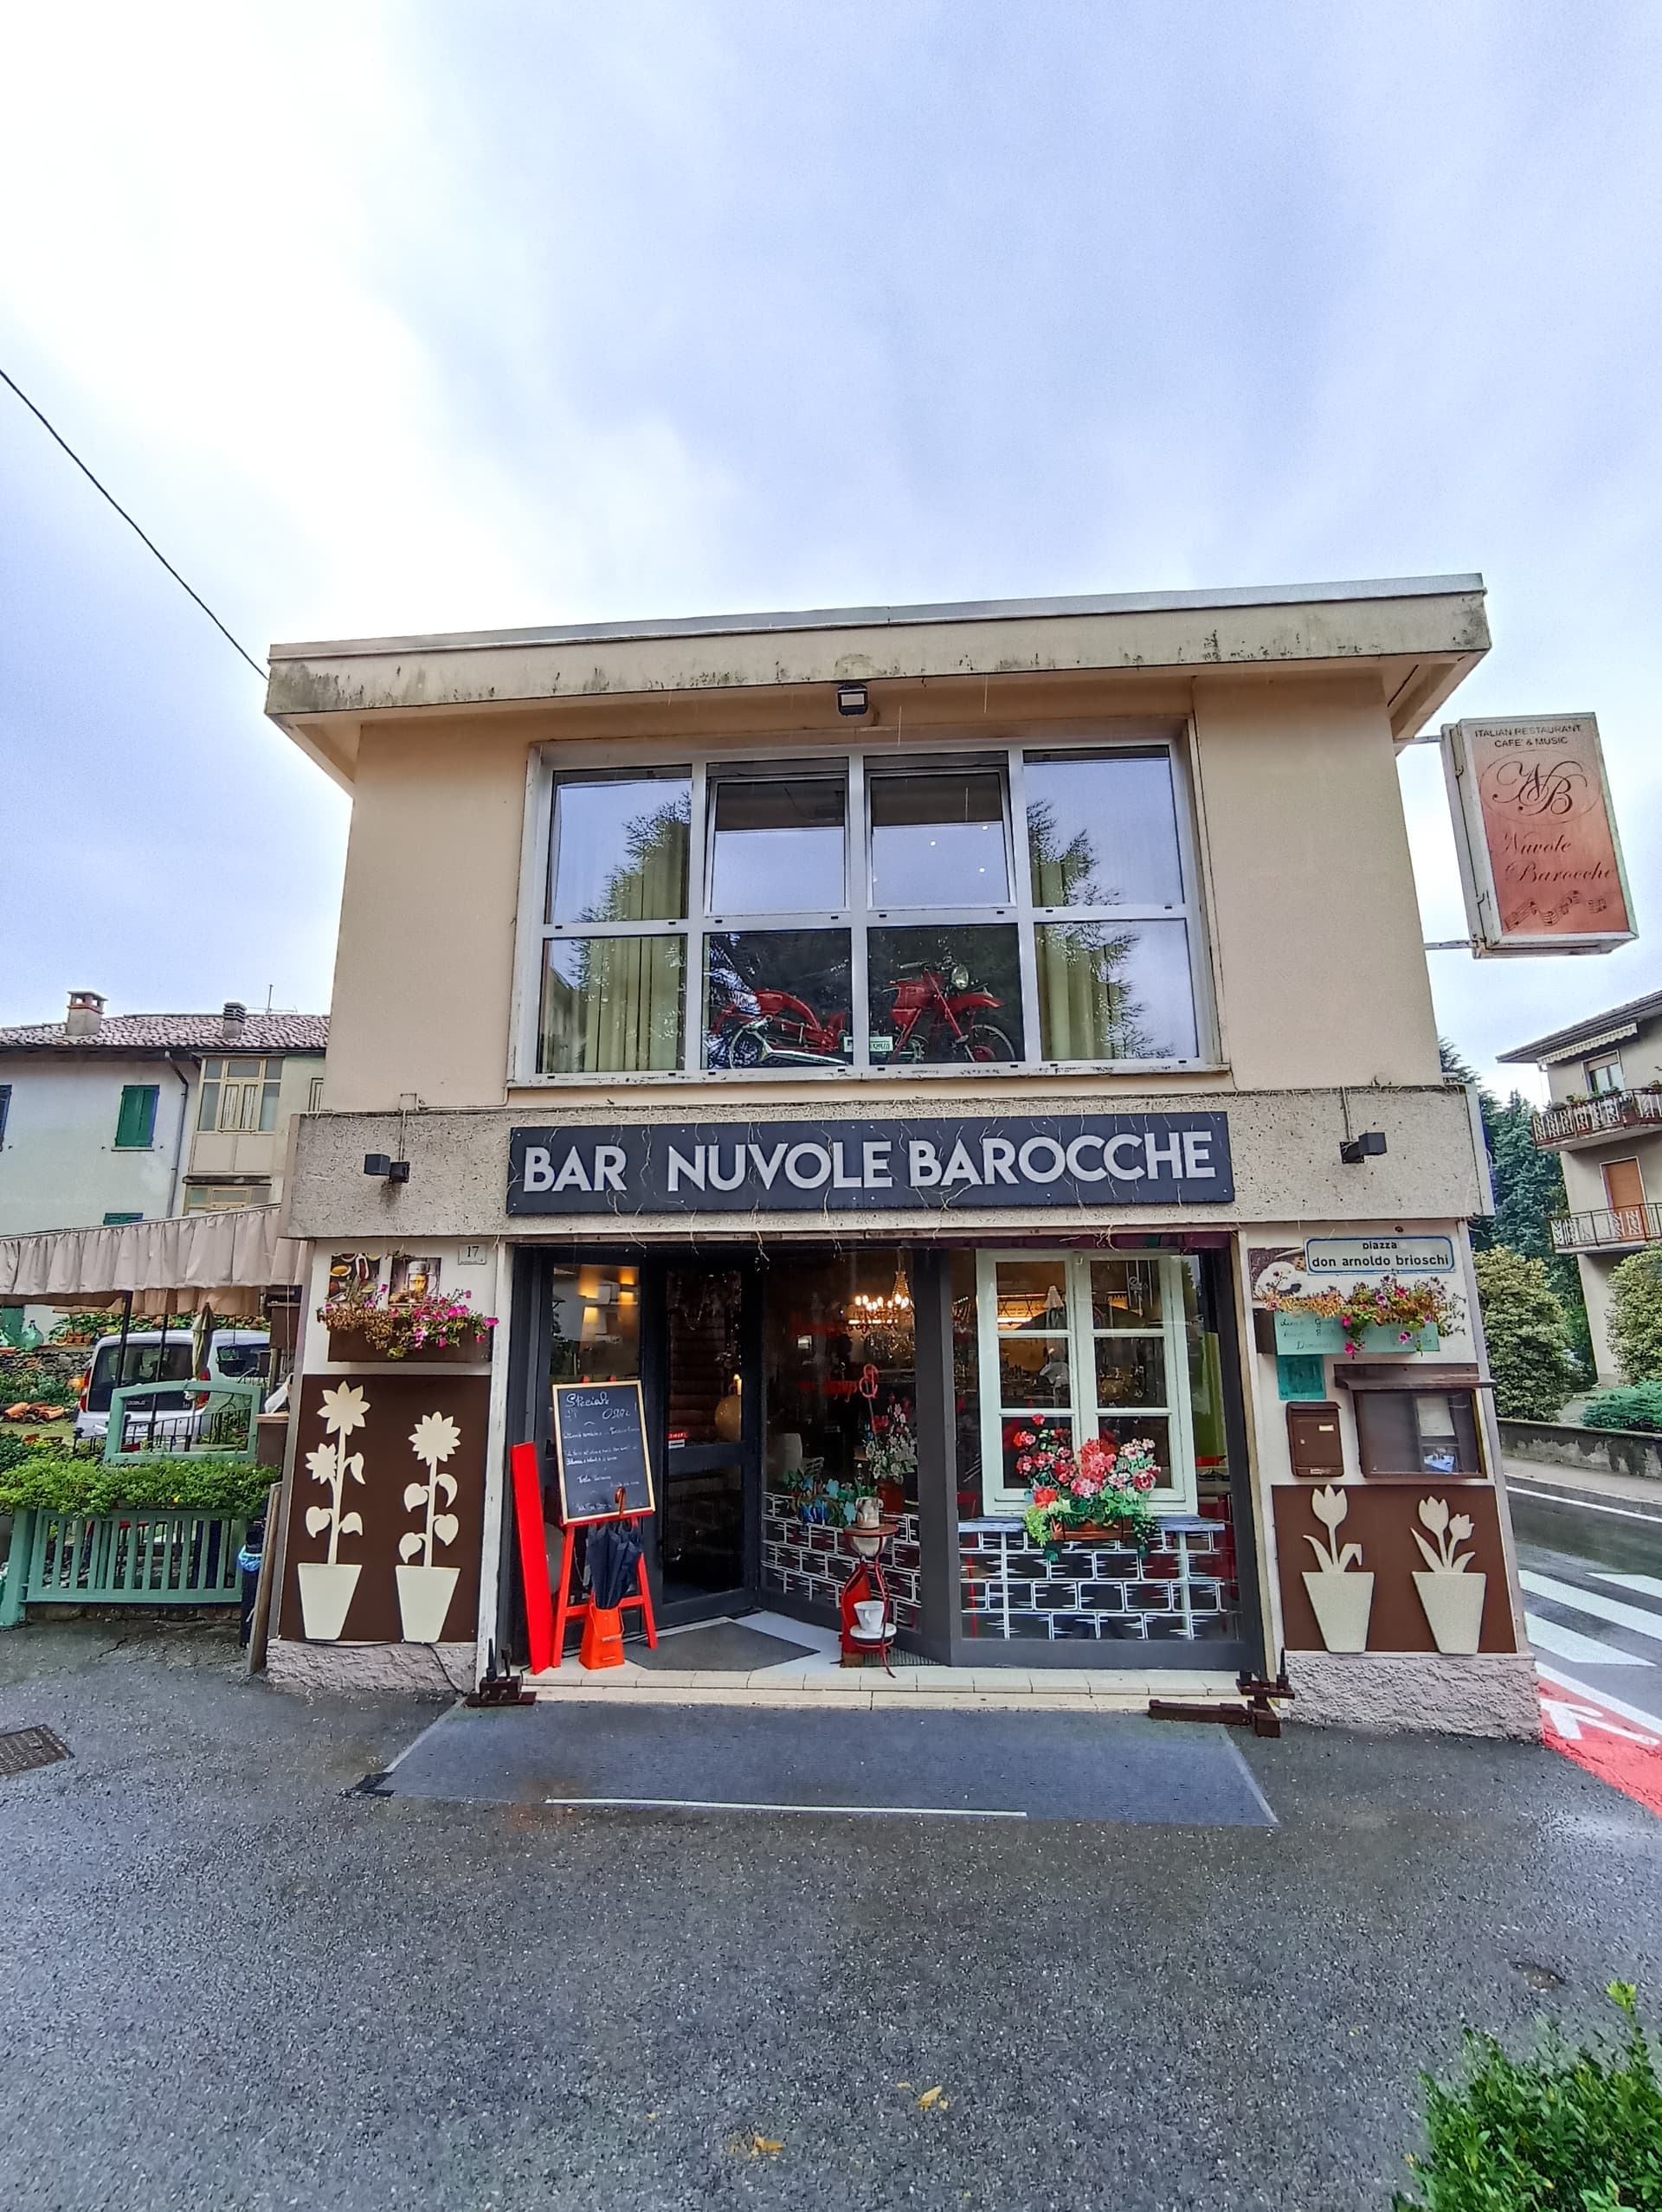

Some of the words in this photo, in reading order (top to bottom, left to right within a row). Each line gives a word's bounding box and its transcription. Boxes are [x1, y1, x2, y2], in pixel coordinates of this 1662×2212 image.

[1474, 728, 1511, 738] ITALIAN
[1515, 724, 1581, 736] RESTAURANT
[1535, 736, 1569, 746] MUSIC
[1502, 831, 1572, 855] Nuvole
[1504, 859, 1613, 883] Barocche
[523, 1145, 628, 1193] BAR
[667, 1140, 892, 1193] NUVOLE
[909, 1130, 1216, 1187] BAROCCHE
[467, 1245, 480, 1257] 17
[1362, 1240, 1398, 1250] piazza
[1311, 1257, 1337, 1267] don
[1342, 1256, 1391, 1266] arnoldo
[1395, 1254, 1449, 1266] brioschi
